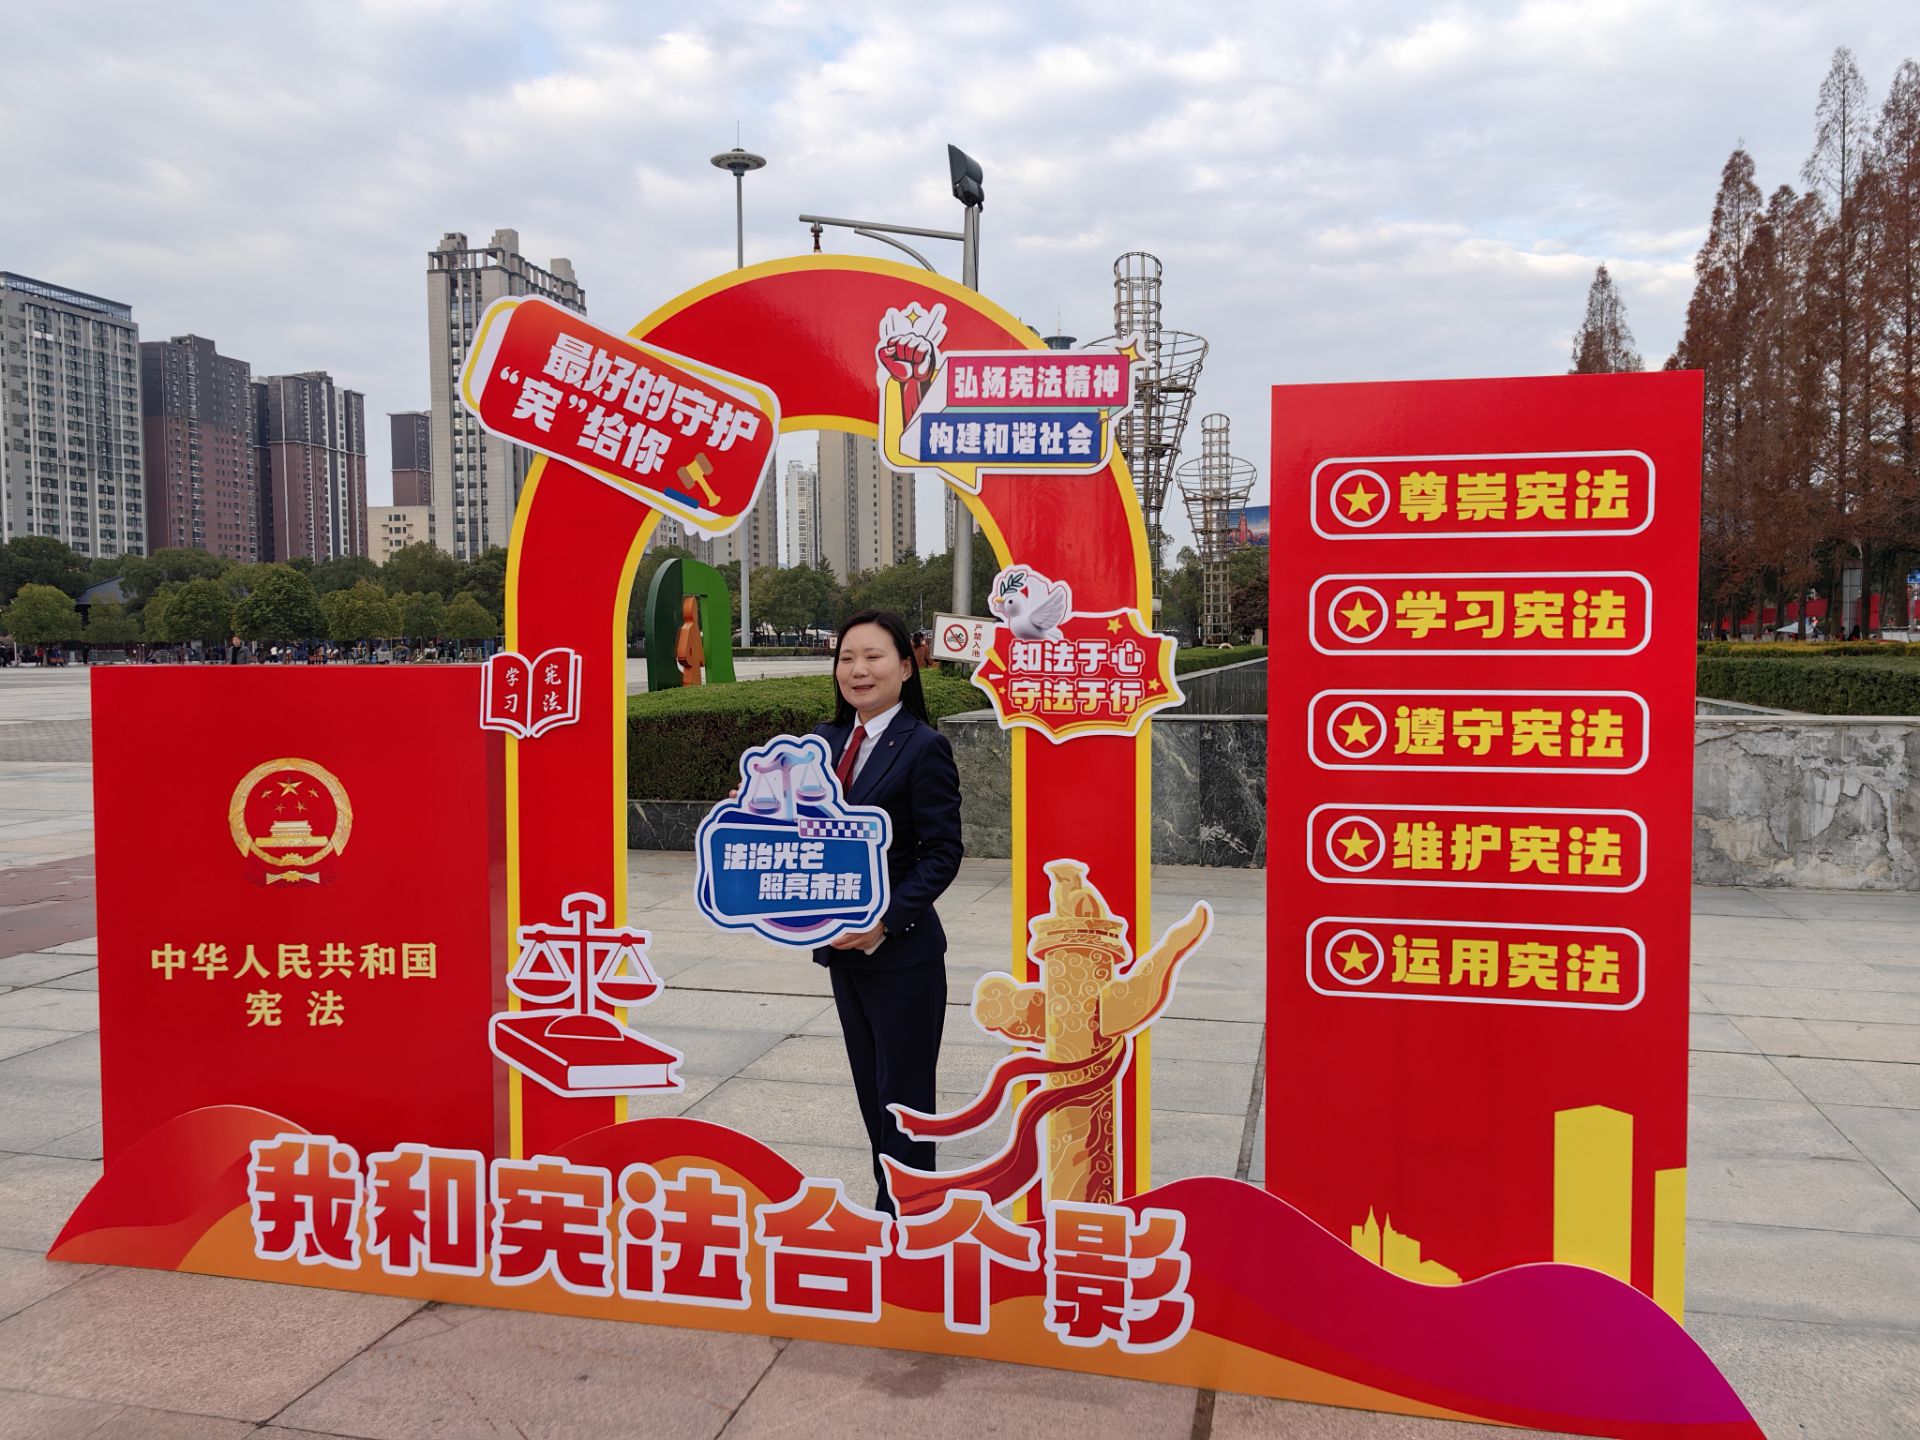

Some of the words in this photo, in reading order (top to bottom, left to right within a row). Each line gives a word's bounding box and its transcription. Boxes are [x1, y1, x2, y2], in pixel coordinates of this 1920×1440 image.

[542, 332, 760, 451] 最好的守护
[954, 365, 1120, 399] 弘扬宪法精神
[929, 422, 1093, 455] 构建和谐社会
[1398, 469, 1629, 522] 尊崇宪法
[1395, 589, 1626, 639] 学习宪法
[1011, 640, 1144, 675] 知法于心
[503, 667, 520, 713] 学习
[542, 663, 563, 712] 宪法
[1010, 679, 1143, 714] 守法于行
[1394, 705, 1624, 758] 遵守宪法
[723, 842, 825, 870] 法治光芒
[1392, 821, 1622, 876] 维护宪法
[758, 872, 862, 901] 照亮未来
[150, 942, 437, 980] 中华人民共和国
[1391, 934, 1620, 994] 运用宪法
[251, 1138, 1188, 1347] 我和宪法合个影
